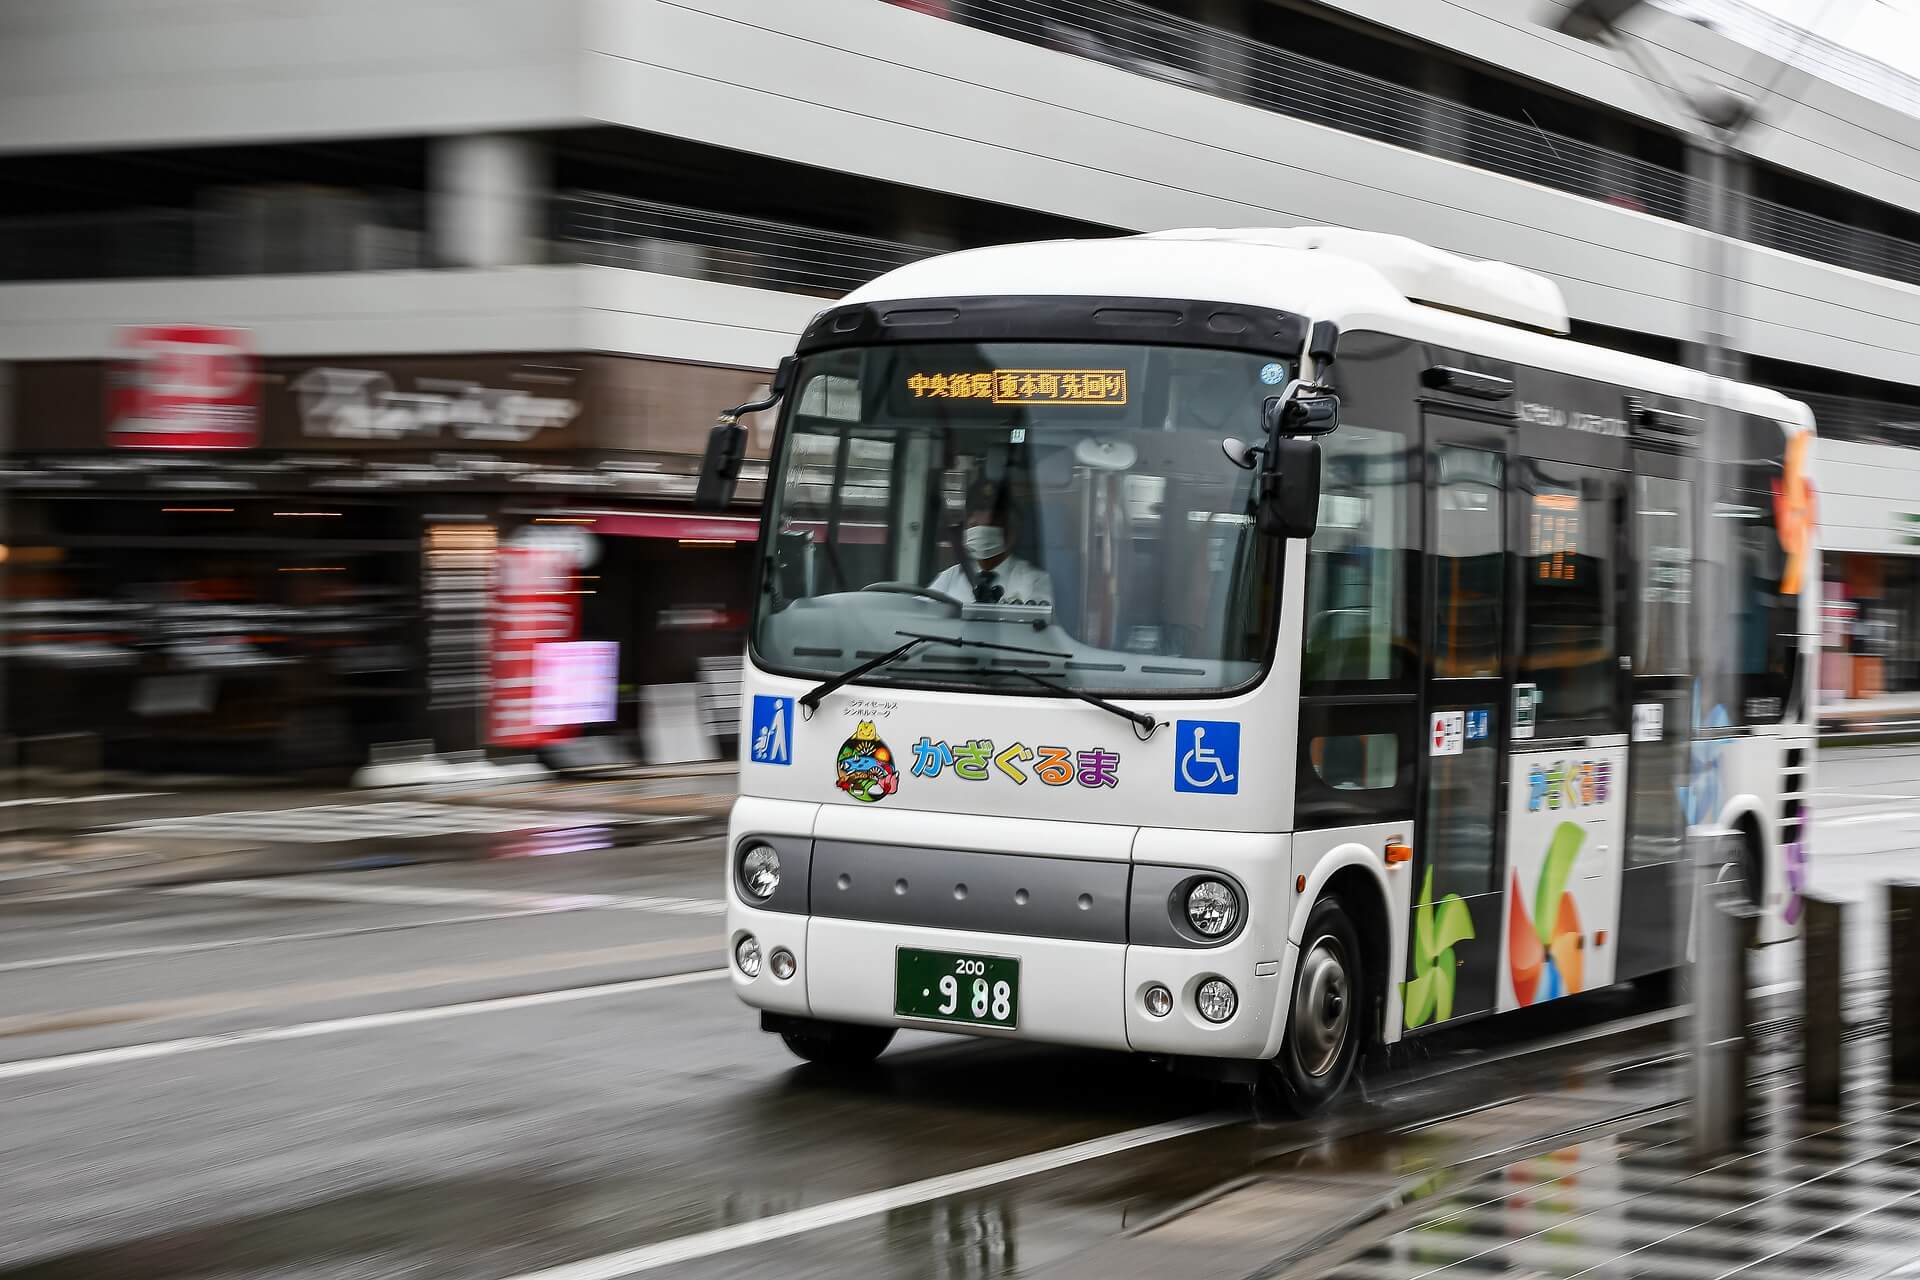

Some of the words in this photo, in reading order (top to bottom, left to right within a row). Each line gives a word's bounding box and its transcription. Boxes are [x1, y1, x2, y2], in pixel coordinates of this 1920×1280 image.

[843, 709, 891, 718] シンボルマーク
[911, 736, 1120, 789] かざぐるま
[955, 959, 985, 976] 200
